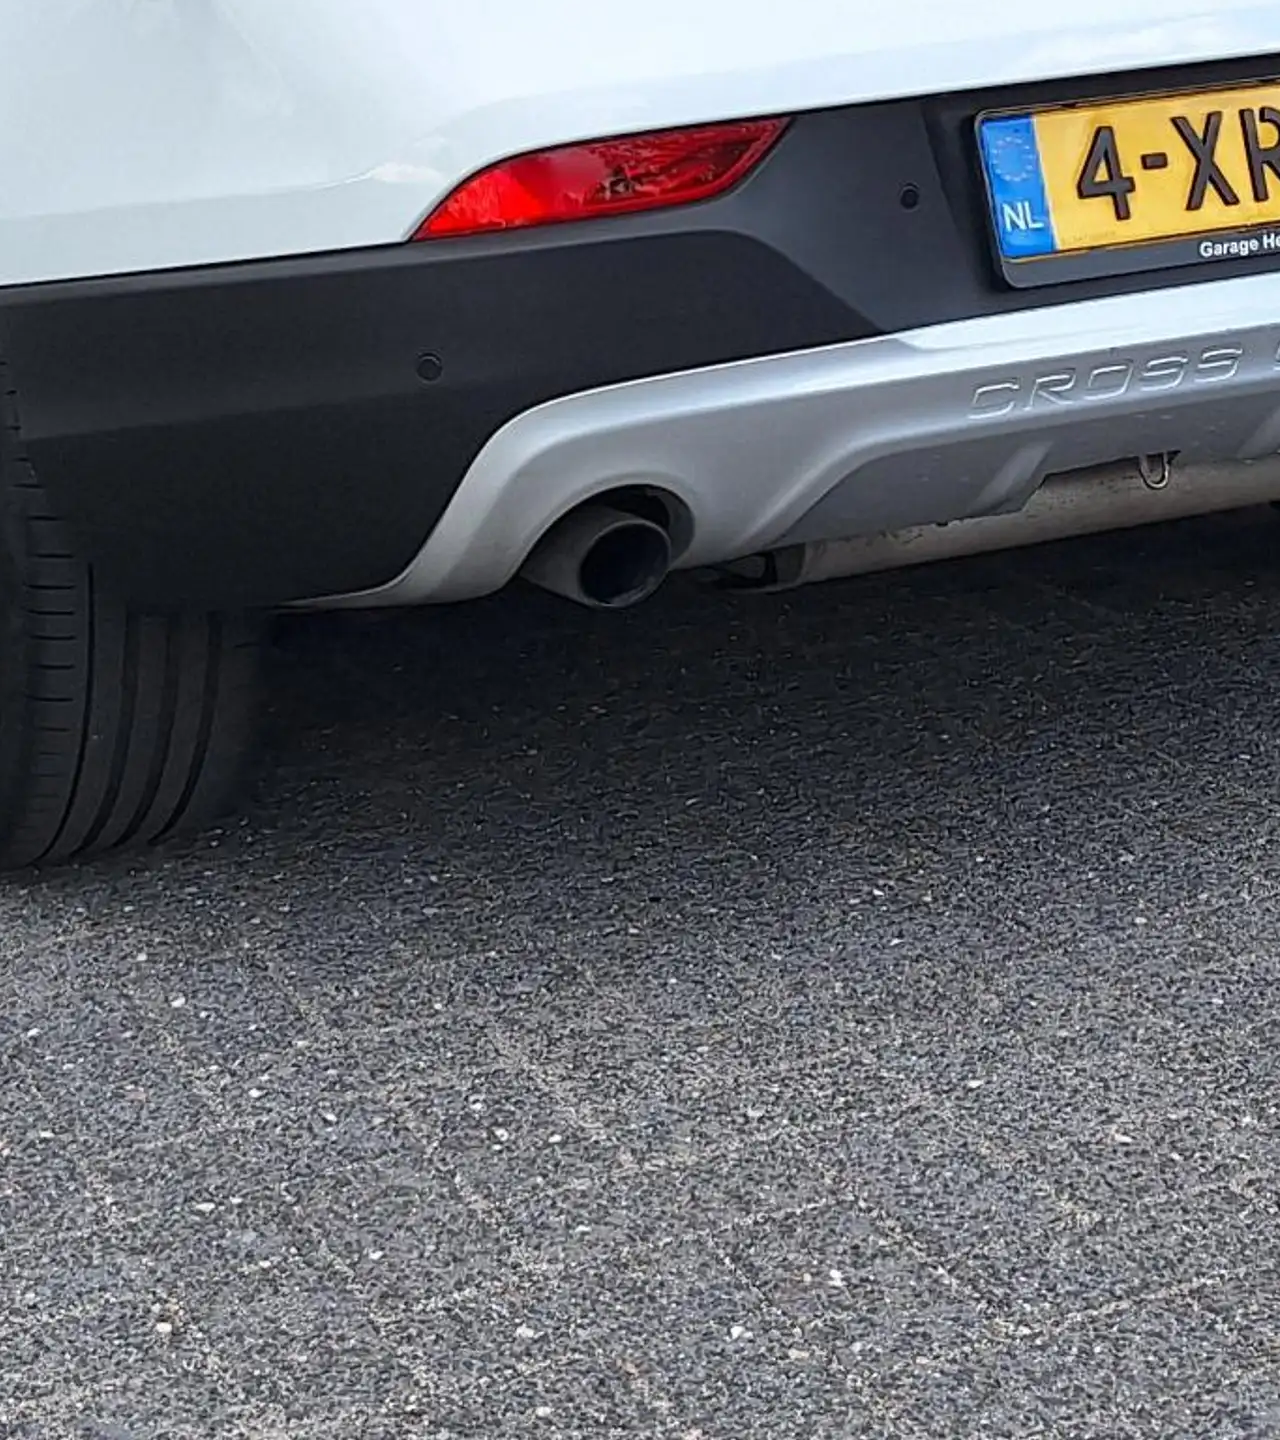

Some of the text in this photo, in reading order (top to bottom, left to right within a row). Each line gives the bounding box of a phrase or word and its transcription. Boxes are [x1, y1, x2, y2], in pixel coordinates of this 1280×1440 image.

[1001, 198, 1045, 234] NL
[1199, 238, 1260, 258] Garage
[966, 345, 1243, 421] CROSS
